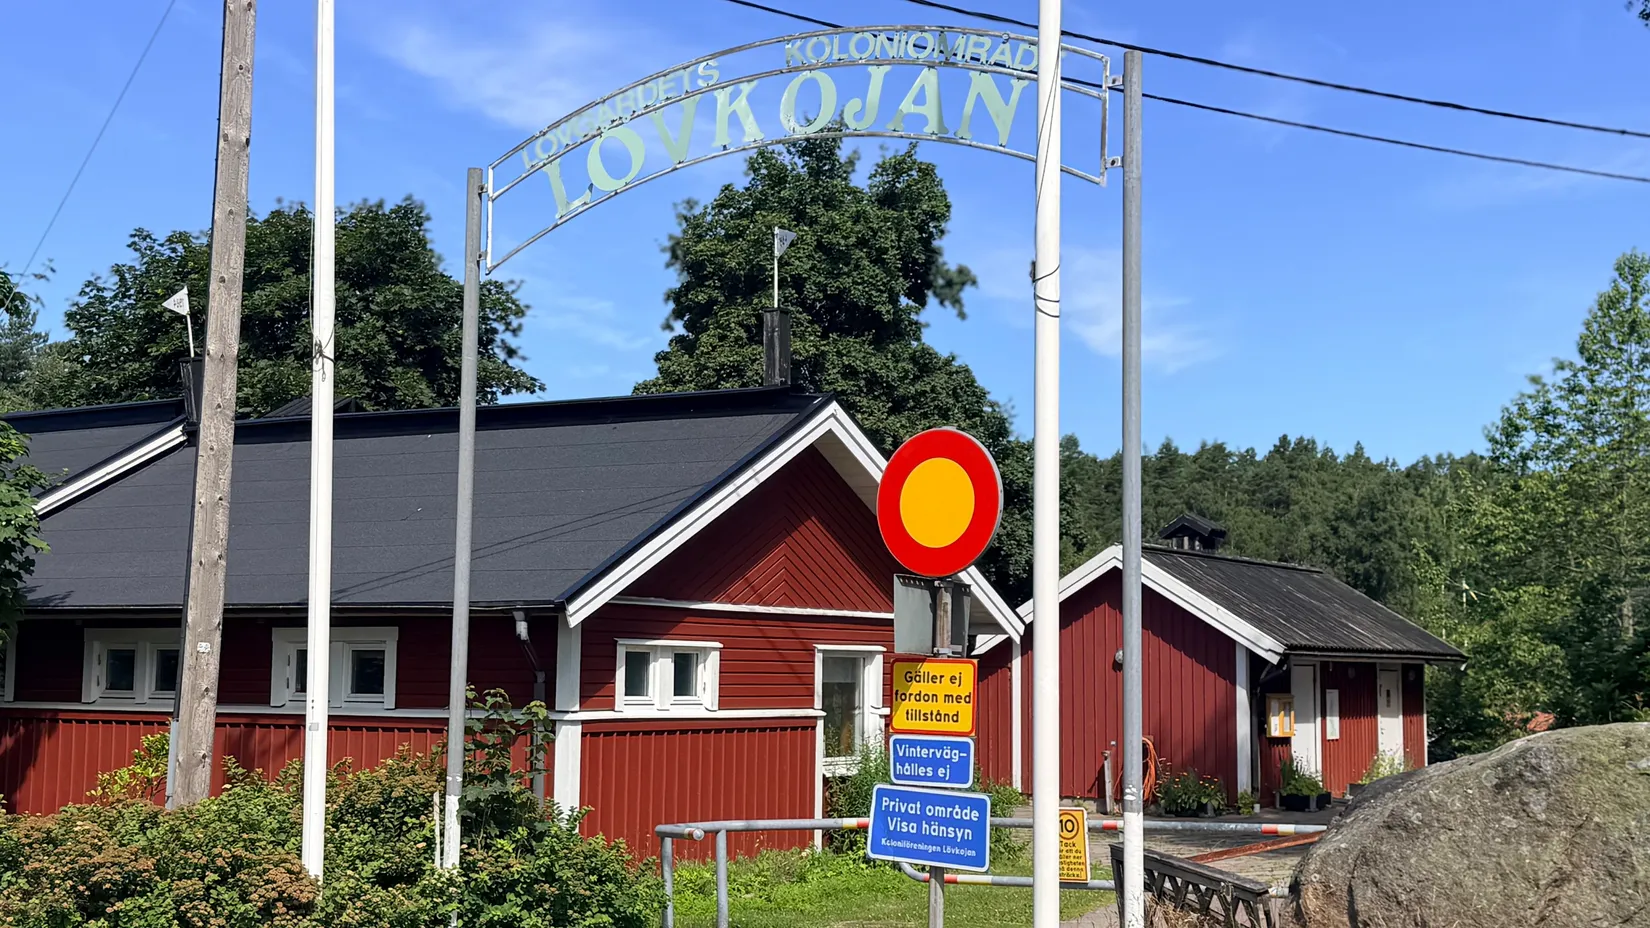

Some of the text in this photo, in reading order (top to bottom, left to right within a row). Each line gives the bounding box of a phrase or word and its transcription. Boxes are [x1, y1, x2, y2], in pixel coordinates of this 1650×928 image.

[784, 31, 1066, 71] KOLONIOMRÅD
[543, 65, 1030, 219] LÖVKOJAN
[904, 670, 962, 687] Gäller ej
[894, 689, 971, 704] fordon med
[905, 709, 960, 723] tillstånd
[896, 744, 967, 762] Vinterväg-
[896, 762, 950, 780] hålles ej
[881, 797, 980, 821] Privat område
[887, 816, 973, 842] Visa hänsyn
[1059, 819, 1075, 833] 10
[942, 845, 976, 857] Lövkojan
[1060, 840, 1076, 848] Tack
